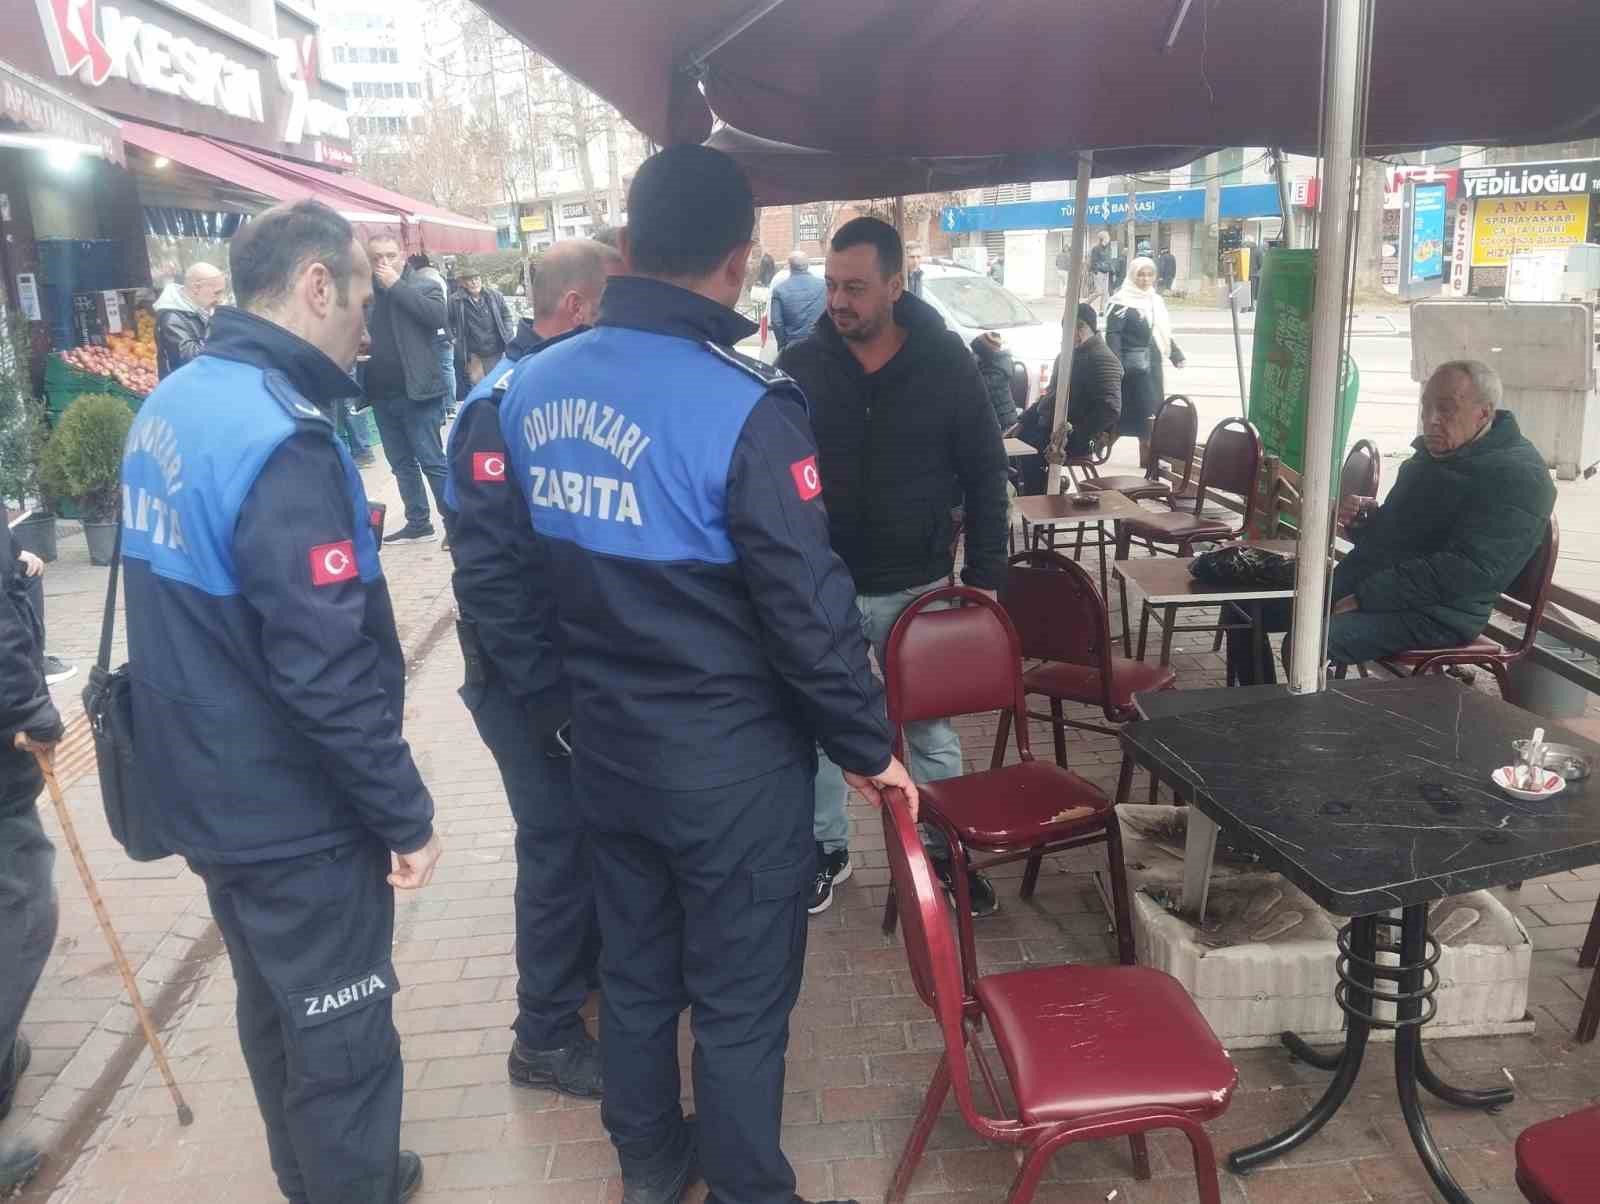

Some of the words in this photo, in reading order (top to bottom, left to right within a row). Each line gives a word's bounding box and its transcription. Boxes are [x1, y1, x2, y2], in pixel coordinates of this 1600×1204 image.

[1464, 169, 1587, 199] YEDİLİOĞLU
[1061, 205, 1100, 217] TÜYE
[1495, 200, 1568, 214] ANKA
[1453, 202, 1468, 291] eczane
[523, 399, 651, 471] ODUNPAZARI
[529, 466, 643, 527] ZABITA
[304, 974, 386, 1017] ZABITA
